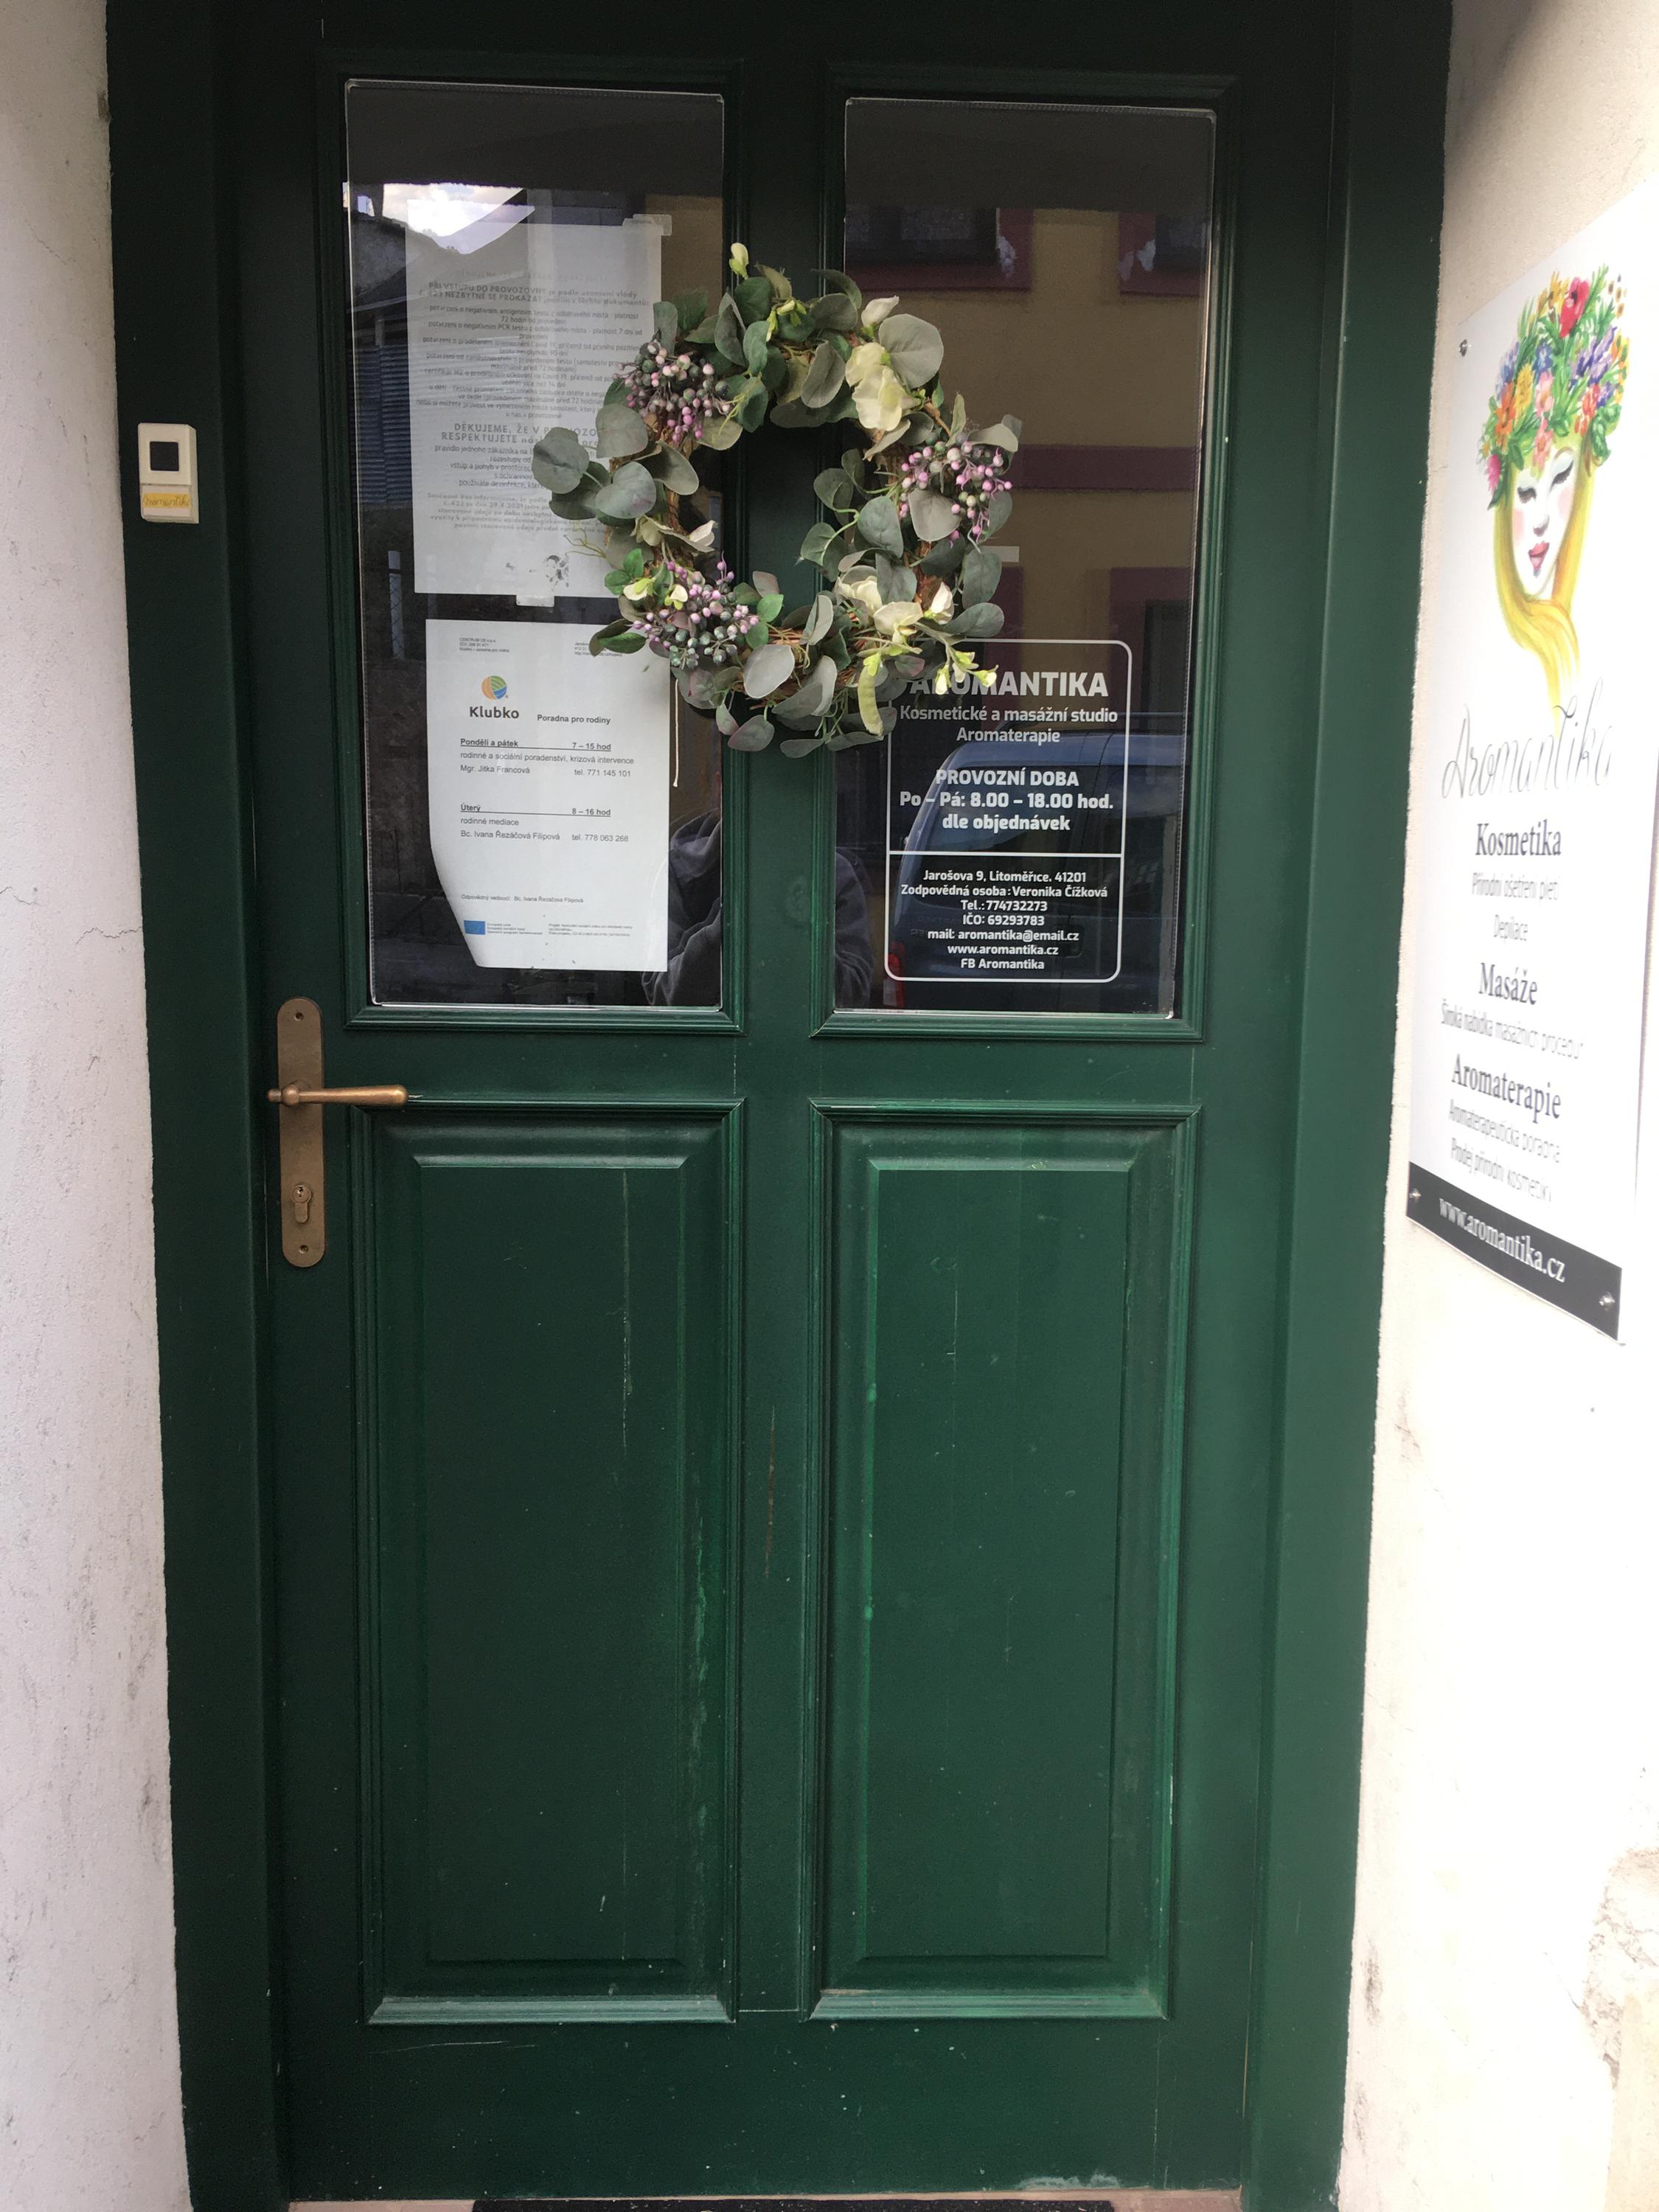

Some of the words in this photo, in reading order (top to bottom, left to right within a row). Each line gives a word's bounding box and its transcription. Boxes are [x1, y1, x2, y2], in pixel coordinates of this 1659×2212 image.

[454, 420, 512, 434] DĚKUJEME,
[517, 423, 529, 434] ŽE
[532, 426, 540, 434] V
[442, 432, 518, 444] RESPEKTUJETE
[909, 671, 1109, 697] AOMANTIKA
[469, 706, 519, 719] Klubko
[900, 705, 988, 720] Kosmetické
[990, 709, 1001, 721] a
[1004, 706, 1069, 722] masážní
[1071, 707, 1119, 723] studio
[537, 714, 569, 722] Poradna
[571, 716, 584, 724] pro
[586, 715, 611, 726] rodiny
[956, 726, 1061, 747] Aromaterapie
[1441, 677, 1613, 799] Aromantika
[497, 740, 519, 748] pátek
[597, 756, 634, 764] intervence
[460, 765, 476, 773] Mgr.
[479, 765, 495, 773] Jitka
[496, 765, 530, 773] Francová
[936, 767, 1026, 786] PROVOZNÍ
[1029, 771, 1080, 787] DOBA
[460, 802, 481, 812] Úterý
[900, 791, 922, 807] Po
[939, 791, 966, 807] Pá:
[970, 792, 1009, 808] 8.00
[1027, 793, 1074, 809] 18.00
[1077, 793, 1114, 810] hod.
[942, 813, 969, 829] dle
[973, 813, 1071, 834] objednávek
[495, 830, 531, 839] Řezáčová
[532, 832, 560, 841] Filipová
[1475, 818, 1562, 856] Kosmetika
[922, 869, 973, 881] Jarošova
[975, 870, 987, 883] 9,
[1054, 872, 1087, 883] 41201
[900, 884, 970, 898] Zodpovědná
[1064, 885, 1108, 898] Čížková
[962, 911, 986, 925] IČO:
[987, 914, 1046, 926] 69293783
[927, 928, 956, 939] mail:
[957, 929, 1080, 942] aromantika@email.cz
[1494, 914, 1528, 945] Depilace
[946, 944, 1060, 956] www.aromantika.cz
[960, 958, 975, 969] FB
[977, 958, 1046, 970] Aromantika
[1478, 962, 1538, 1005] Masáže
[1450, 1053, 1562, 1124] Aromaterapie
[1439, 1197, 1566, 1283] www.aromantika.cz
